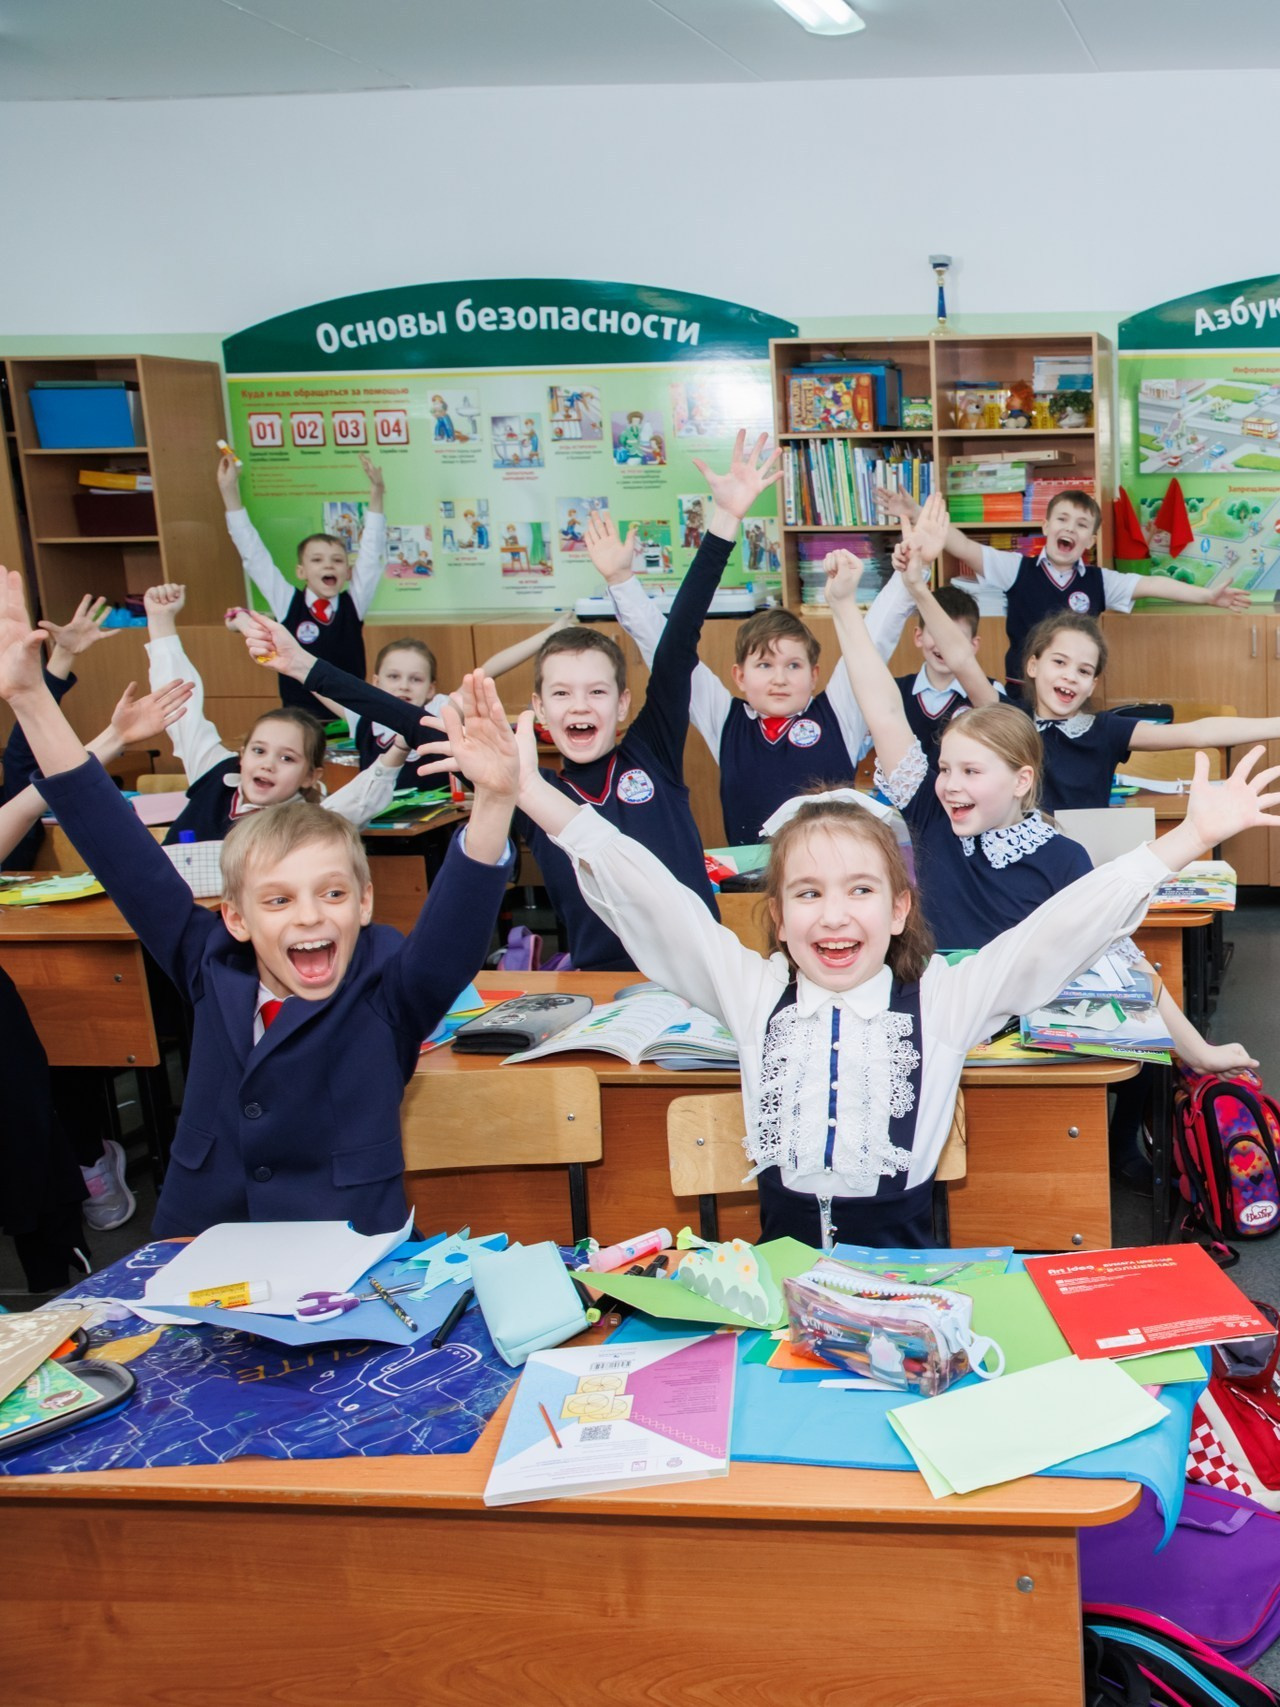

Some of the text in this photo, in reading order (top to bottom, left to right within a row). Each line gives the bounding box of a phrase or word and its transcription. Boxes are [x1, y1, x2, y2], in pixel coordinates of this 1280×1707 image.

[315, 298, 701, 354] Основы безопасности
[241, 389, 265, 399] Куда
[275, 390, 291, 398] как
[293, 387, 349, 398] обращаться
[351, 388, 361, 396] за
[363, 387, 410, 396] помощью
[256, 421, 276, 441] 01
[297, 420, 319, 440] 02
[338, 420, 360, 439] 03
[380, 418, 402, 438] 04
[1047, 1267, 1065, 1276] Art
[1103, 1260, 1136, 1268] БУМАГА
[1106, 1261, 1178, 1273] ВОЛШЕБНАЯ
